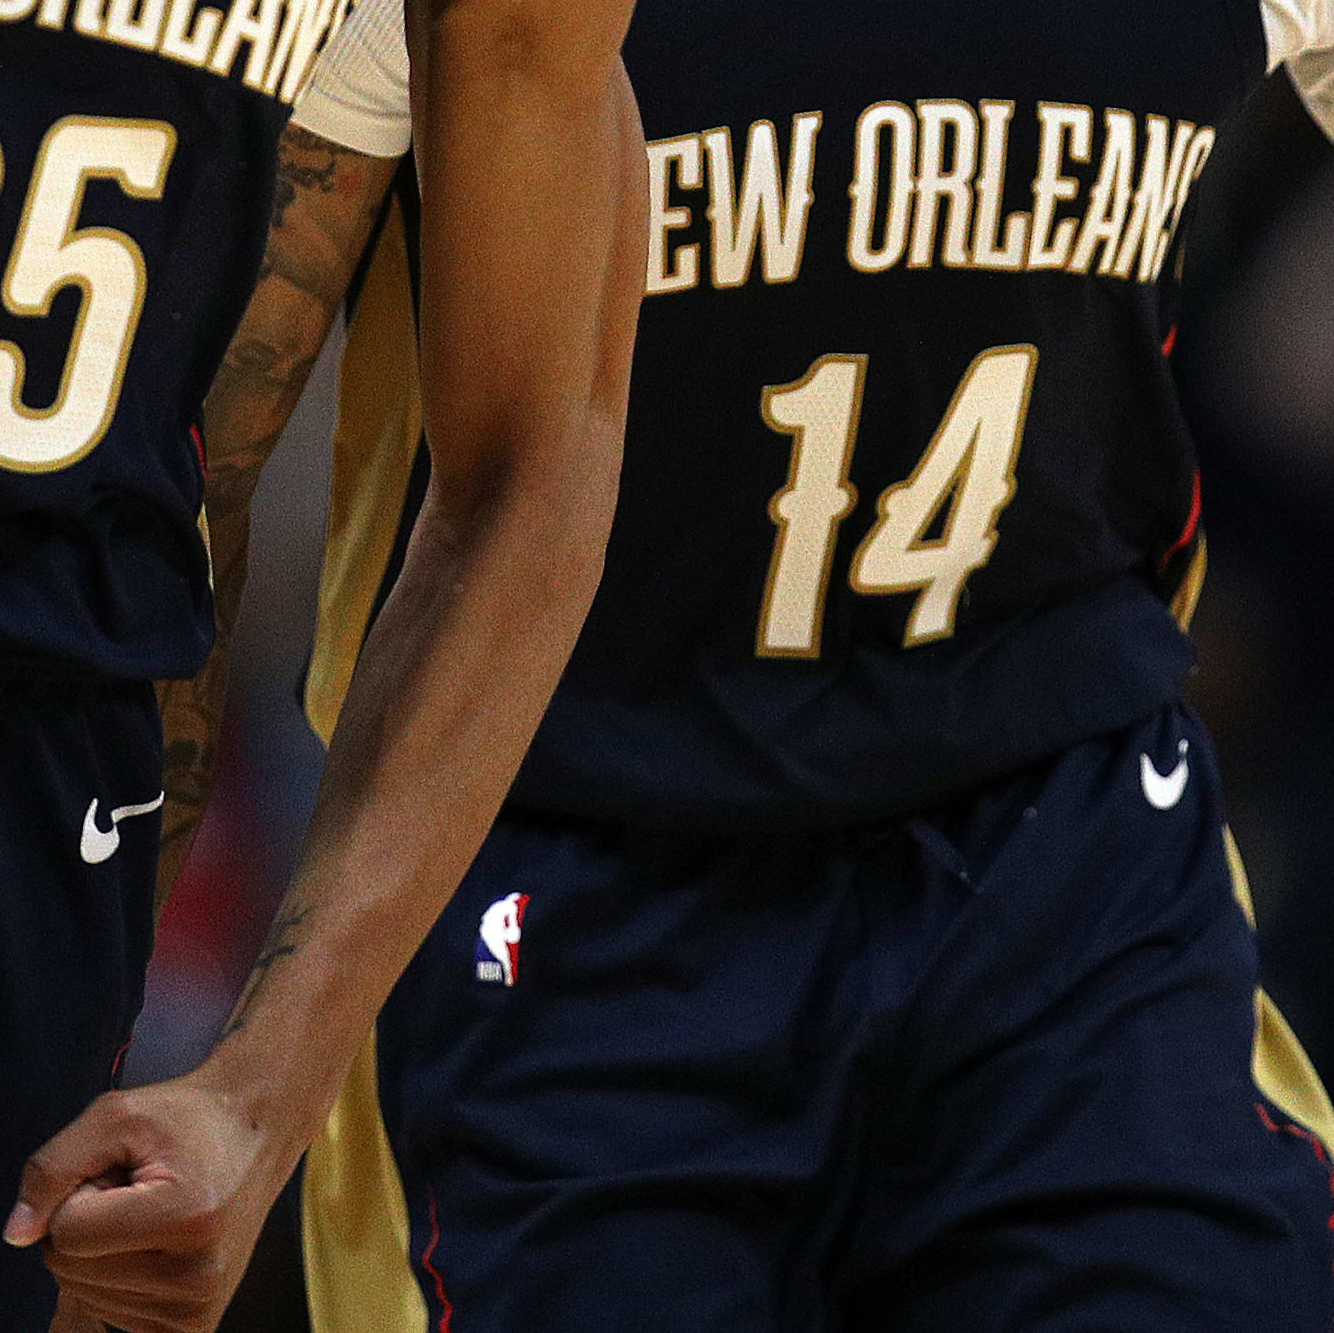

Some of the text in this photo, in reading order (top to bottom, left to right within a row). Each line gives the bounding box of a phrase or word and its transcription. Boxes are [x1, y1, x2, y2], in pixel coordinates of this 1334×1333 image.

[646, 97, 1217, 297] EW ORLEANS
[755, 342, 1040, 658] 14
